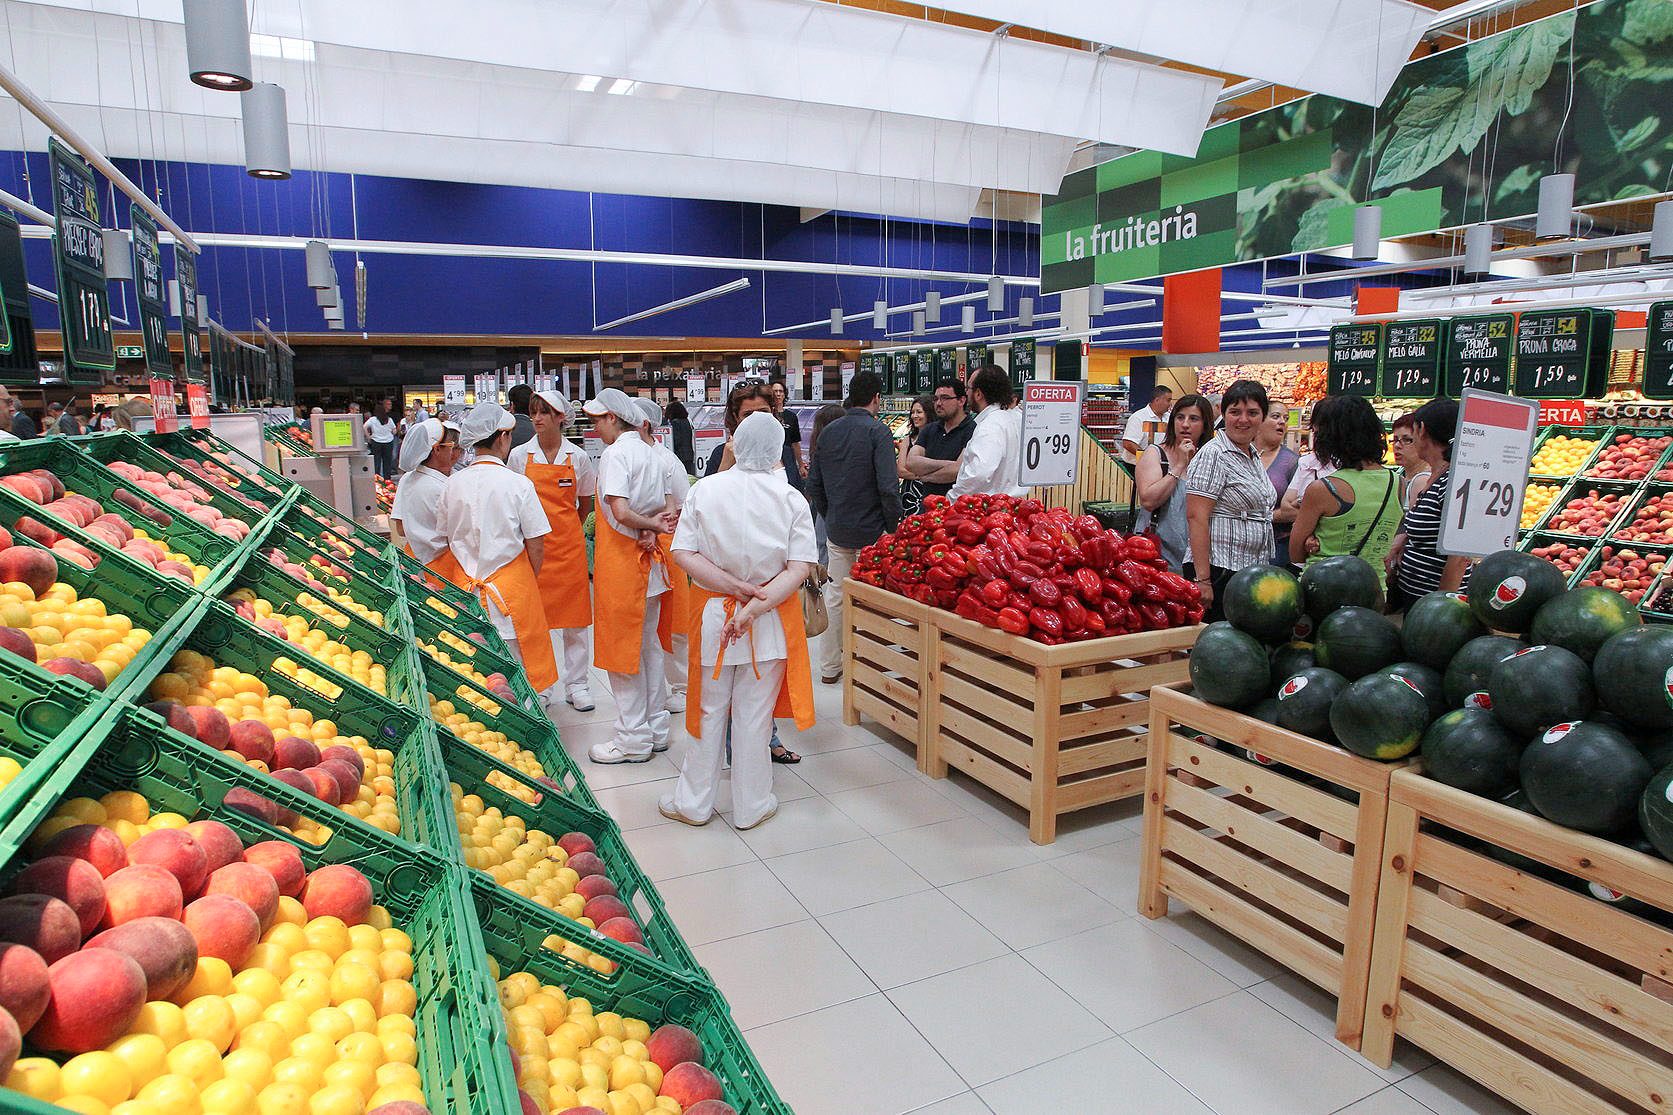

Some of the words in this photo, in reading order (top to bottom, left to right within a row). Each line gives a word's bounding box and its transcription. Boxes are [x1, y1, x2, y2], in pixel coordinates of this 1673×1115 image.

[1066, 230, 1085, 261] la
[1090, 205, 1197, 256] fruiteria
[1490, 321, 1507, 338] 52
[1341, 370, 1363, 390] 1,29
[1396, 369, 1421, 390] 1,29
[1462, 366, 1490, 387] 2,69
[1534, 365, 1564, 388] 1,59
[1031, 388, 1072, 400] OFERTA
[1538, 408, 1582, 423] ERTA
[1026, 433, 1071, 471] 0'99
[1455, 478, 1515, 530] 1'29
